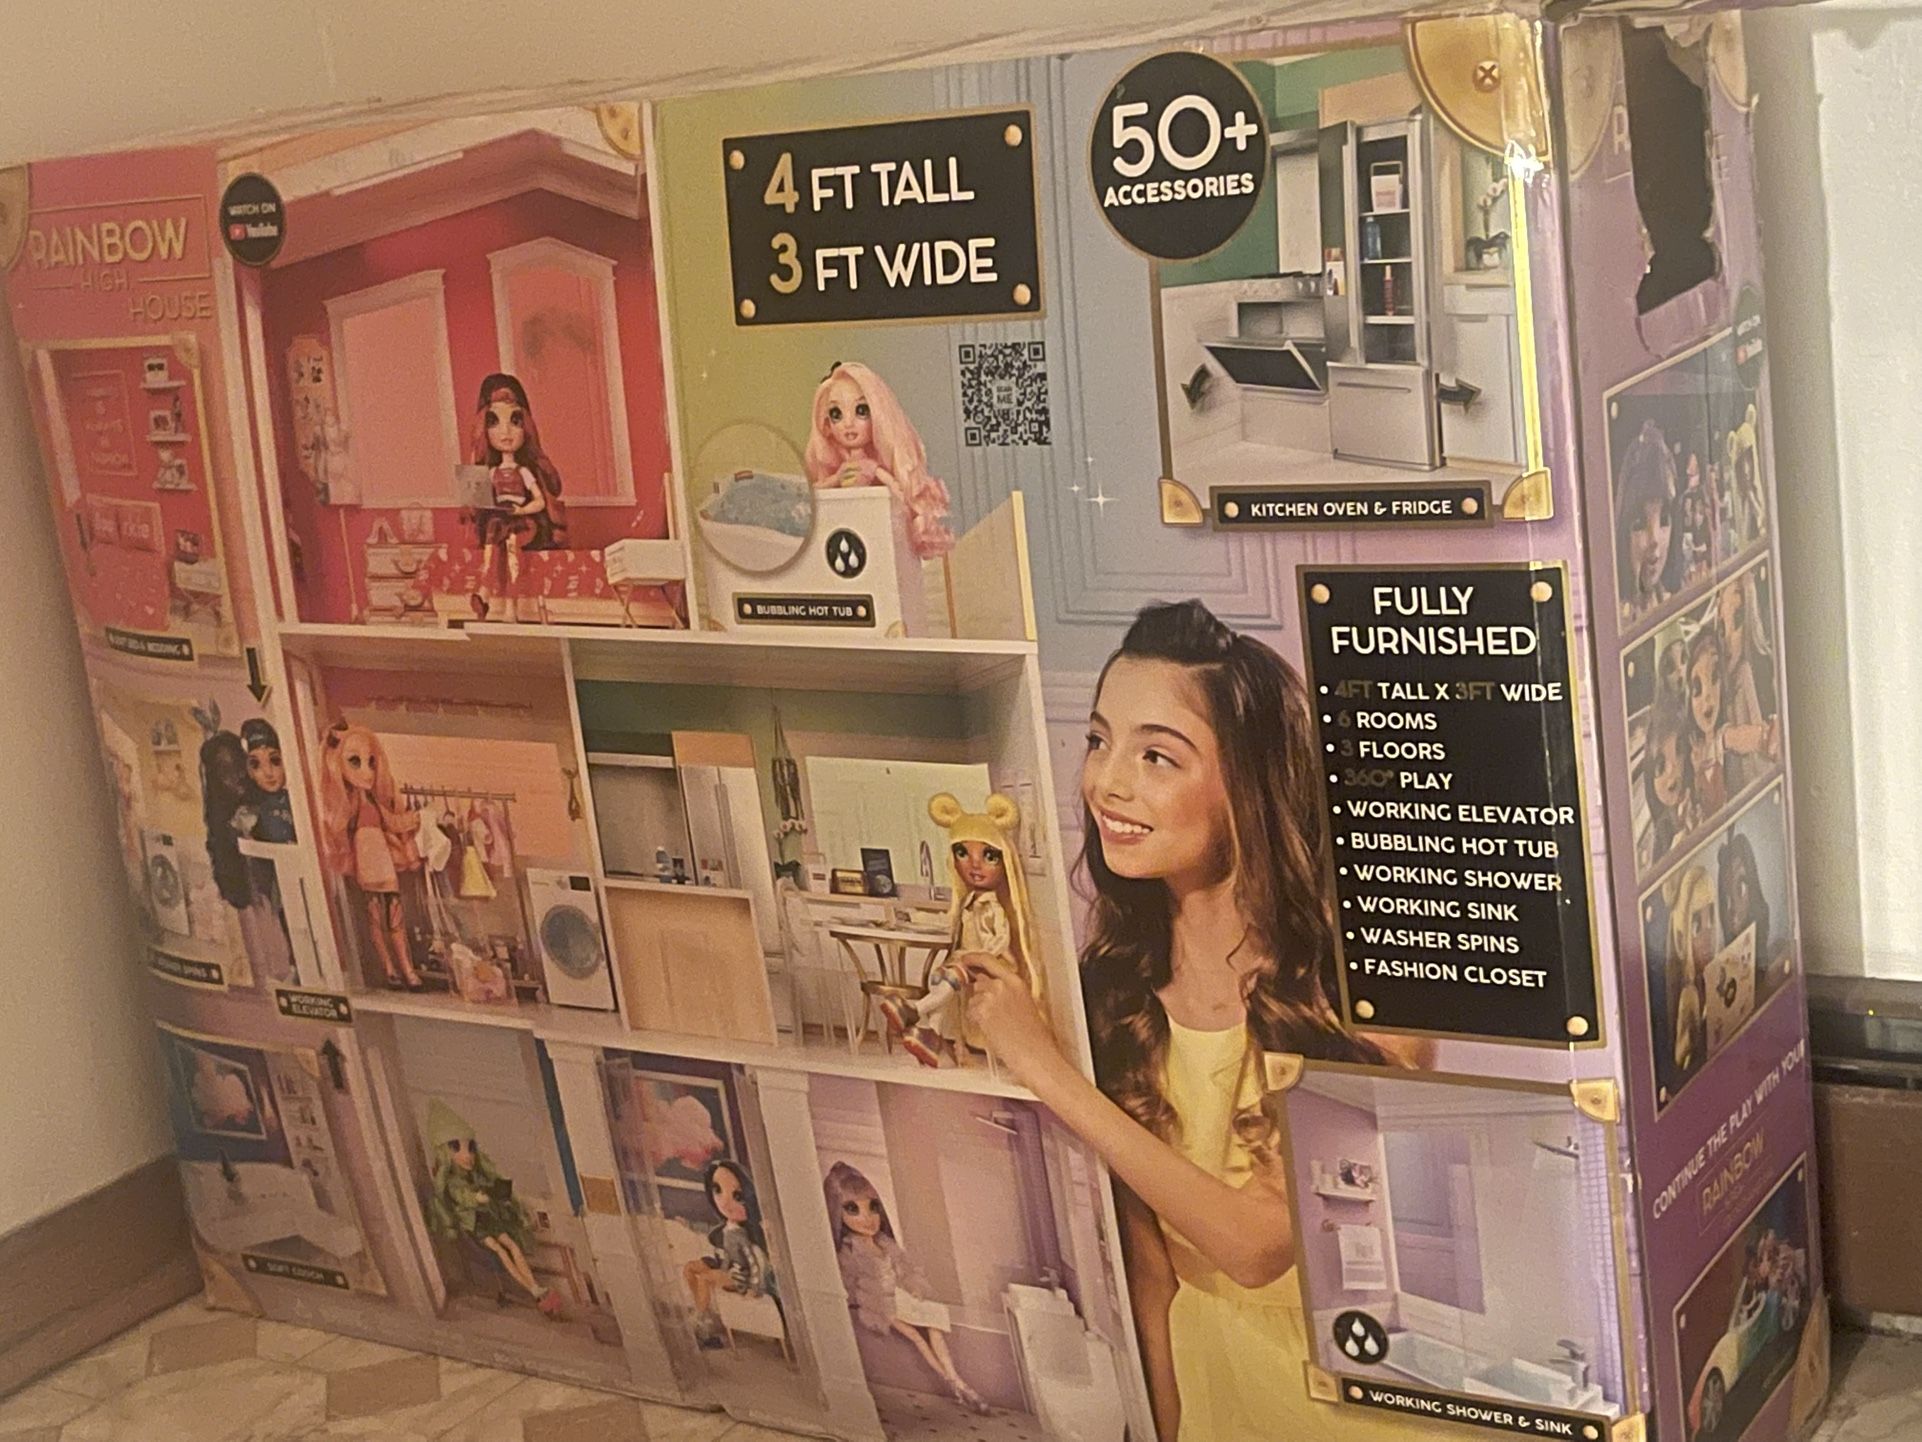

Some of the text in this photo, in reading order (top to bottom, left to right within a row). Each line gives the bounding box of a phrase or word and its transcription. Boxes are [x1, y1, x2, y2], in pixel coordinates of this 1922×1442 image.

[1112, 94, 1258, 178] 50+
[764, 152, 975, 214] 4 FT TALL
[1103, 172, 1255, 207] ACCESSORIES
[261, 202, 276, 214] ON
[28, 216, 187, 269] RAINBOW
[769, 232, 998, 294] 3 FT WIDE
[80, 267, 131, 292] HIGH
[130, 291, 212, 322] HOUSE
[1250, 499, 1453, 517] KITCHEN OVEN & FRIDGE
[756, 604, 853, 617] BUBBLING HOT TUB
[1373, 586, 1474, 615] FULLY
[1331, 626, 1537, 655] FURNISHED
[1334, 680, 1373, 699] 4FT
[1377, 682, 1430, 700] TALL
[1455, 681, 1496, 700] 3FT
[1500, 682, 1563, 701] WIDE
[1338, 710, 1438, 730] 6 ROOMS
[1341, 739, 1446, 760] 3 FLOORS
[1400, 771, 1453, 790] PLAY
[1347, 800, 1575, 825] WORKING ELEVATOR
[1351, 832, 1559, 858] BUBBLING HOT TUB
[1353, 864, 1562, 892] WORKING SHOWER
[1357, 895, 1519, 922] WORKING SINK
[1360, 927, 1520, 954] WASHER SPINS
[1364, 958, 1547, 988] FASHION CLOSET
[292, 1003, 338, 1019] ELEVATOR
[1652, 1146, 1706, 1219] CONTINUE
[1706, 1122, 1728, 1157] THE
[1729, 1094, 1754, 1136] PLAY
[1754, 1066, 1780, 1105] WITH
[1702, 1126, 1764, 1215] RAINBOW
[1369, 1389, 1573, 1436] WORKING SHOWER & SINK
